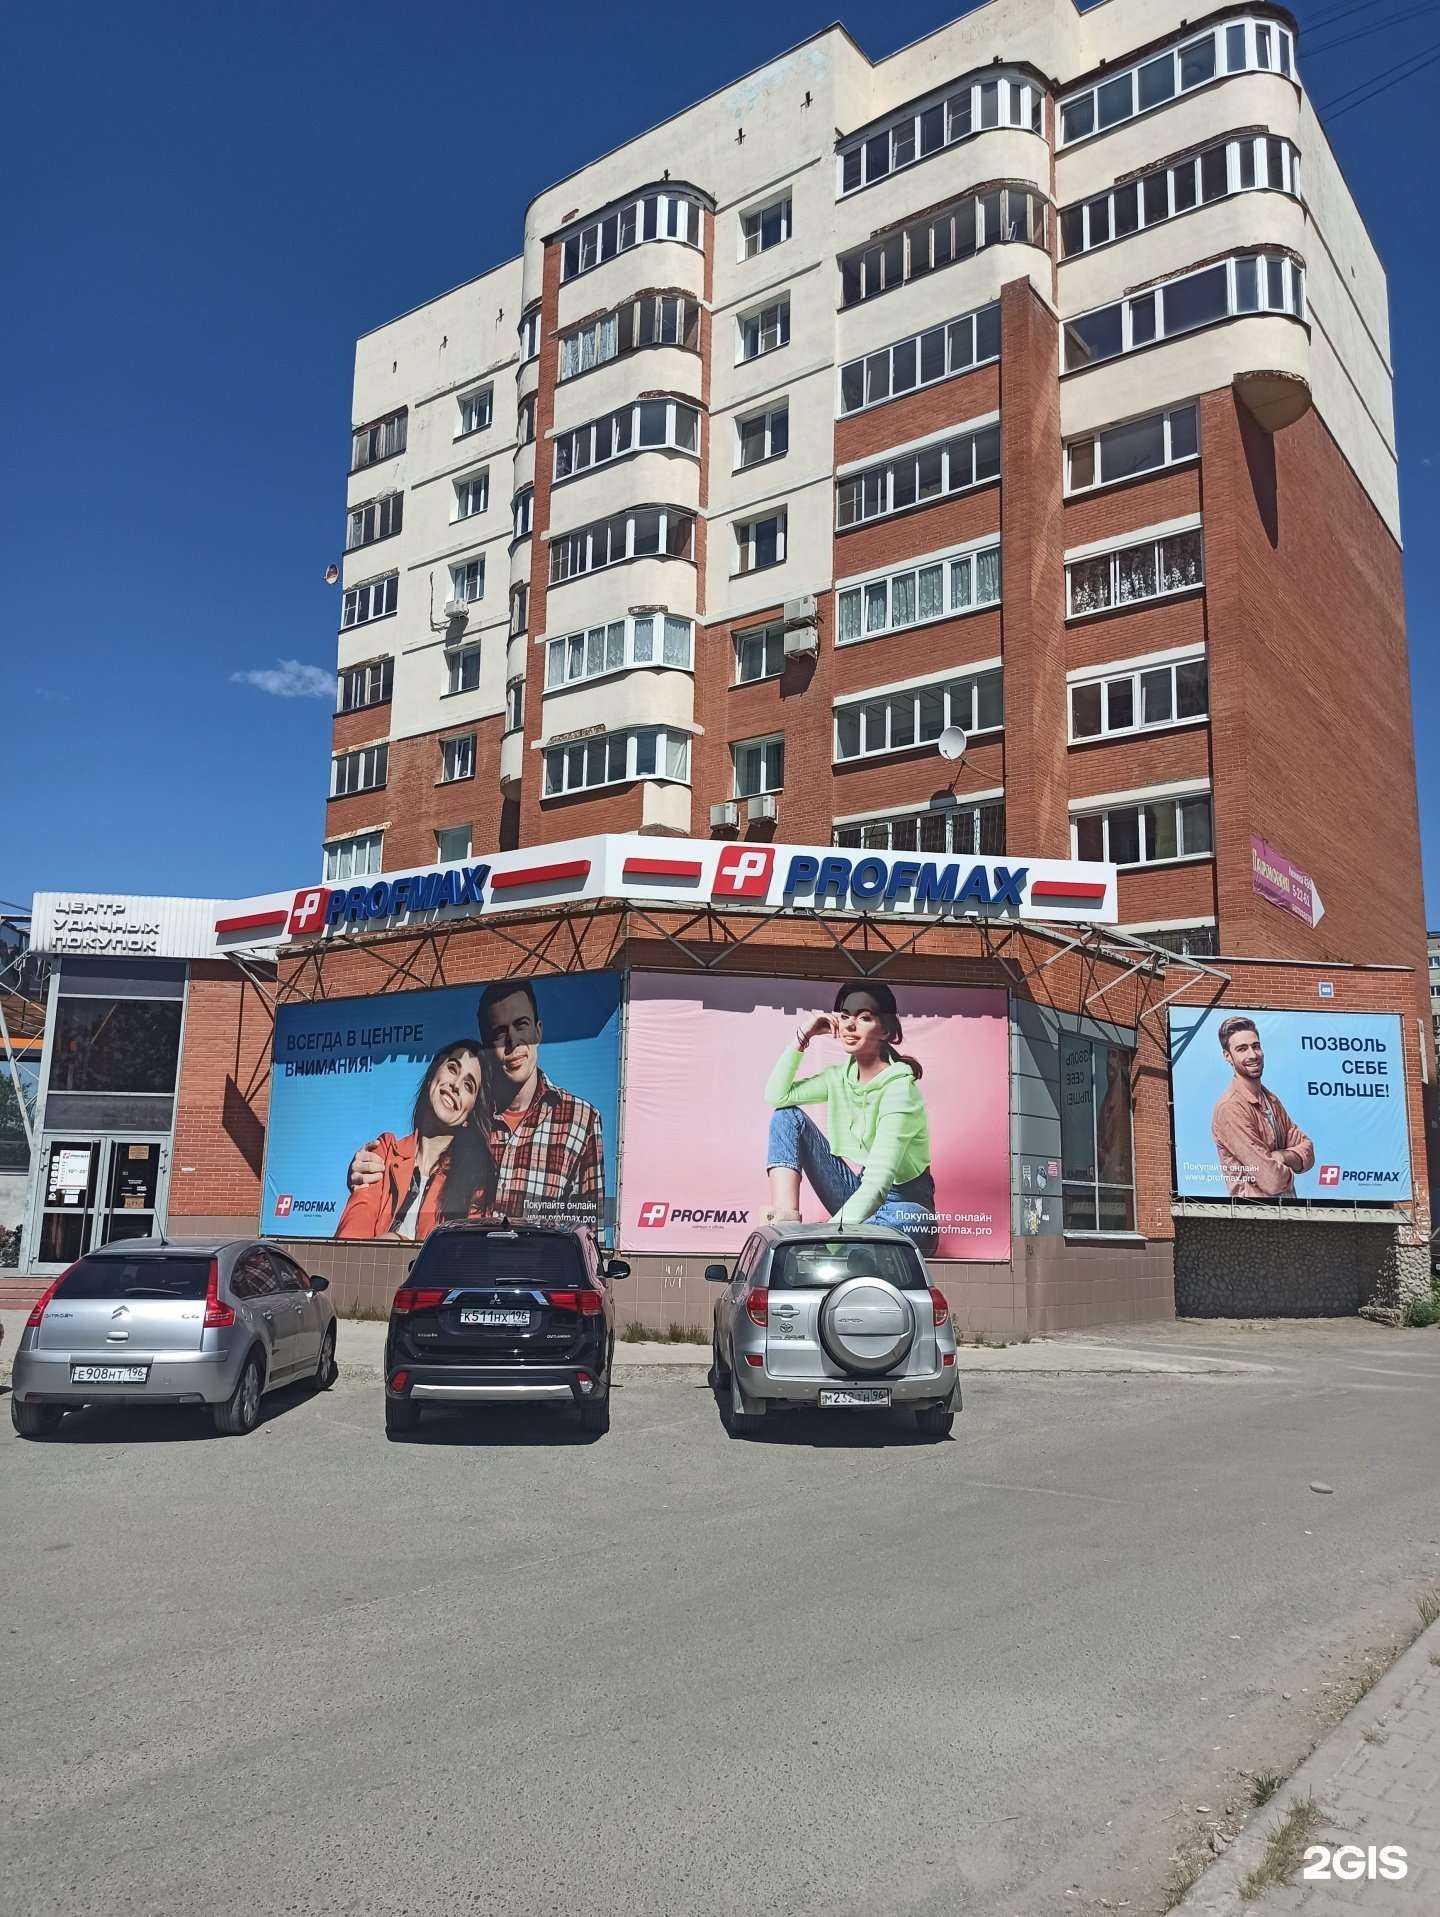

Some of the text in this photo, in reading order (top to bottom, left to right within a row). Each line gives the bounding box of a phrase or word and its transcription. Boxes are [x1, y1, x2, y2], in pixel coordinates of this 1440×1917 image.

[783, 855, 1029, 905] PROFMAX
[325, 864, 491, 925] PROFMAX
[55, 901, 126, 915] ЦЕНТР
[53, 919, 160, 934] УДАЧНЫХ
[52, 937, 157, 952] ПОКУПОК
[287, 1024, 424, 1052] ВСЕГДА В ЦЕНТРЕ
[1301, 1036, 1386, 1052] ПОЗВОЛЬ
[285, 1056, 373, 1077] ВНИМАНИЯ!
[1342, 1060, 1388, 1075] СЕБЕ
[1307, 1081, 1389, 1097] БОЛЬШЕ!
[1183, 1162, 1260, 1173] Покупайте онлайн
[1185, 1173, 1256, 1183] www.profmax.pro
[1342, 1171, 1400, 1181] PROFMAX
[293, 1200, 336, 1212] PROFMAX
[523, 1200, 597, 1211] Покупайте онлайн
[670, 1209, 749, 1223] PROFMAX
[896, 1210, 992, 1223] Покупайте онлайн
[902, 1225, 992, 1236] www.profmax.pro
[127, 1367, 145, 1377] 196
